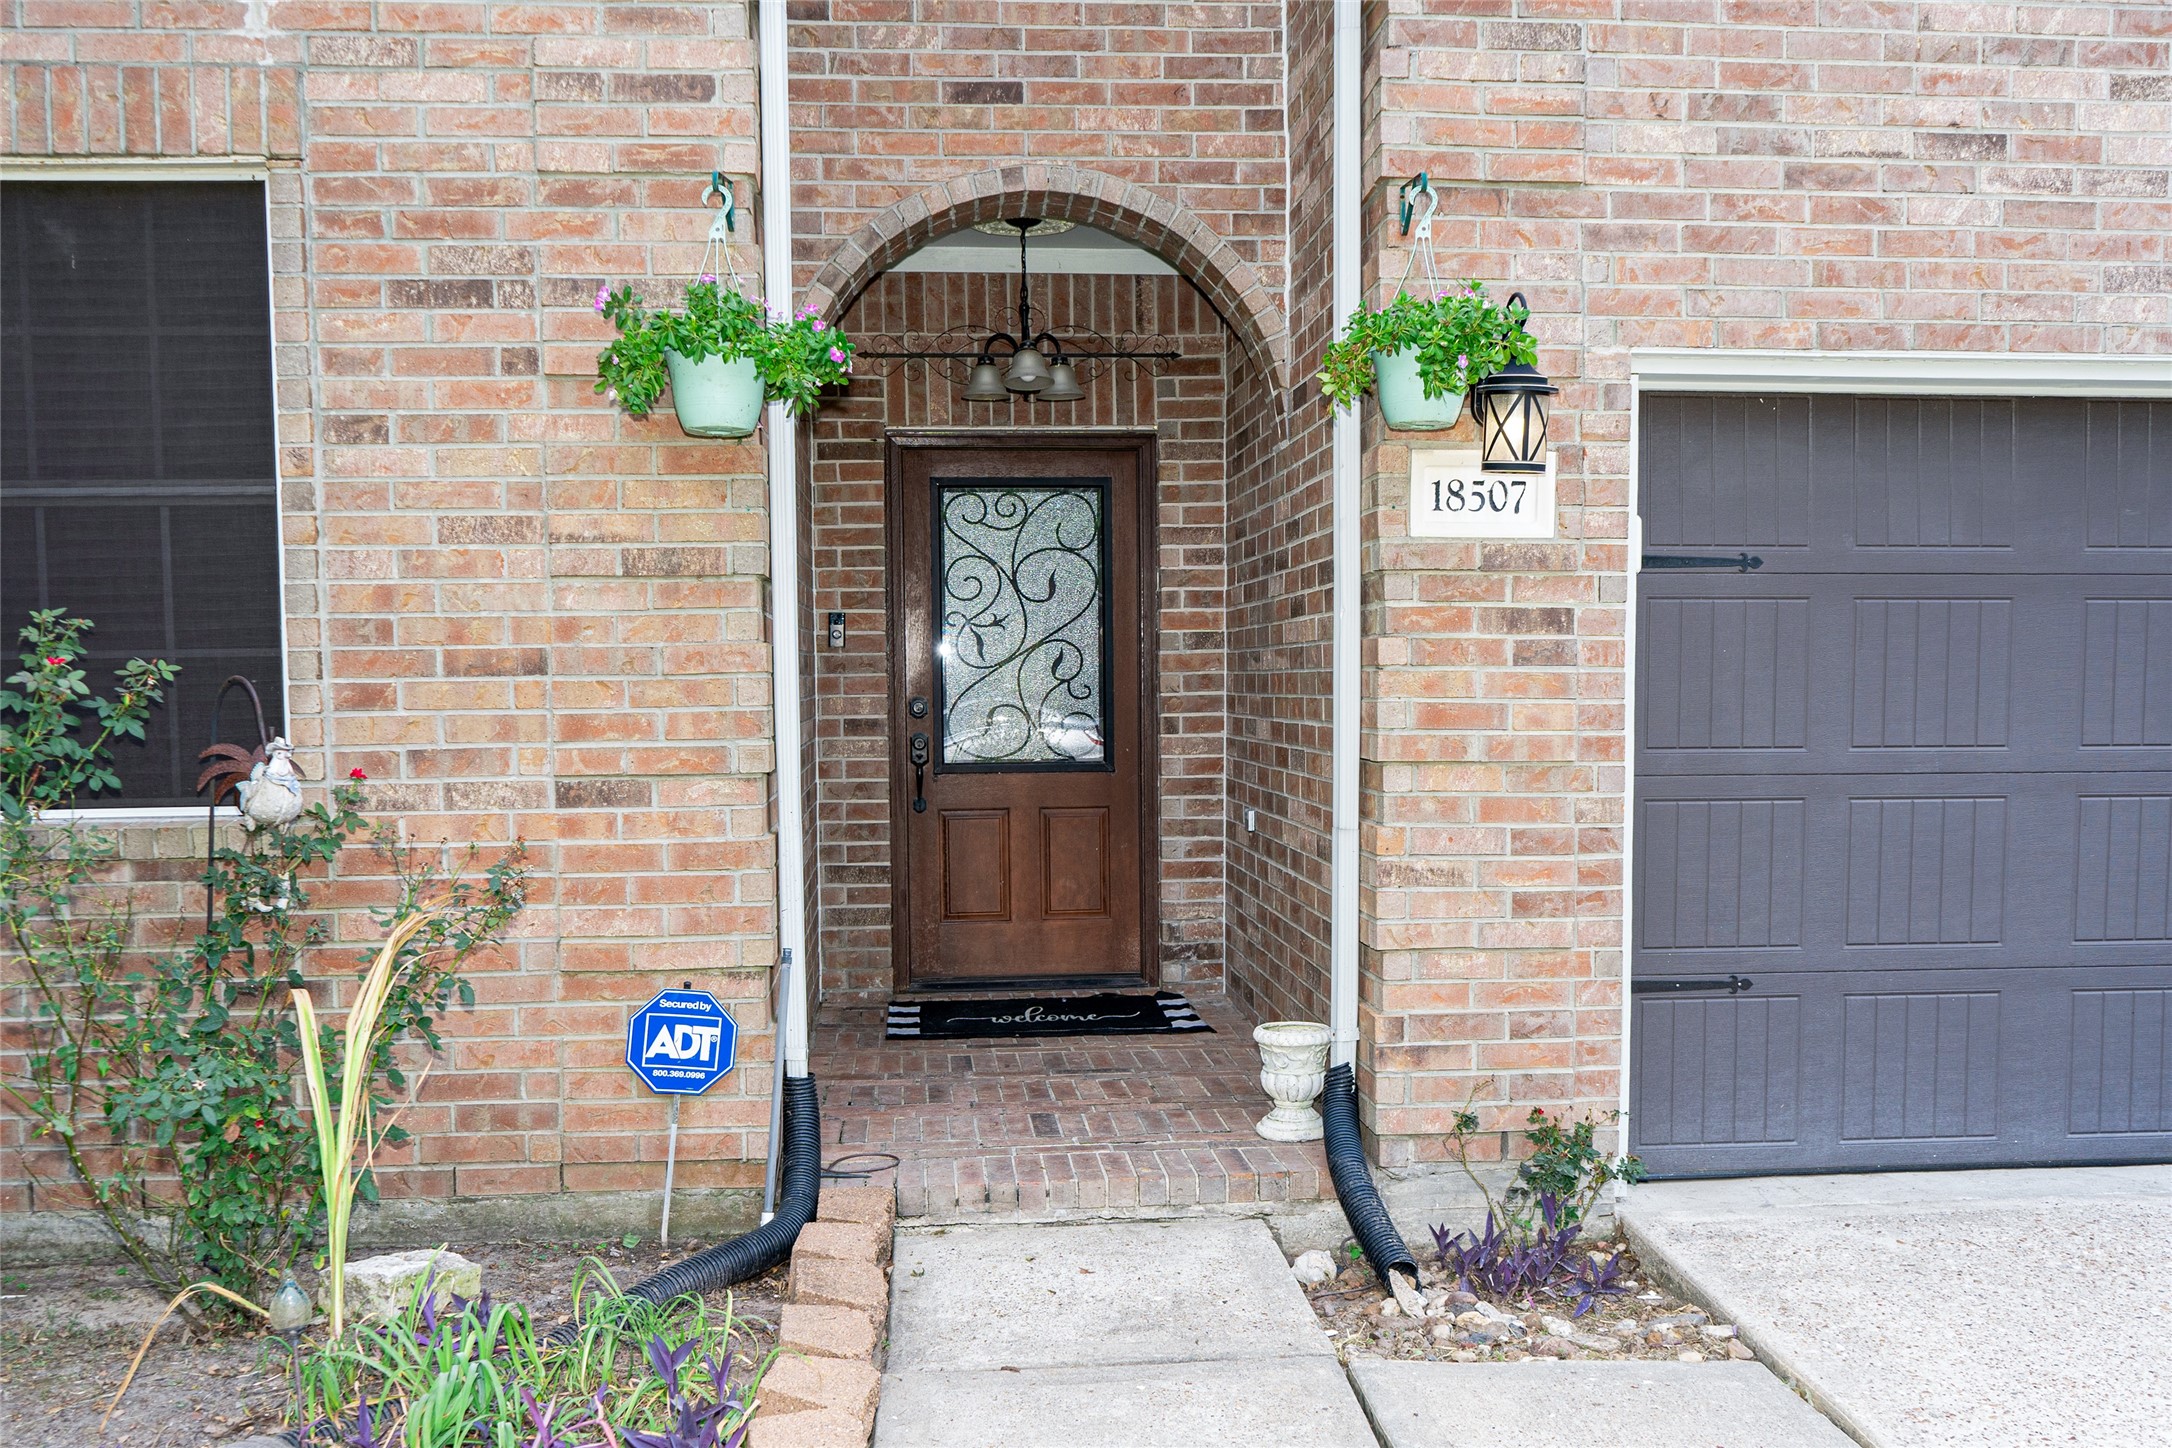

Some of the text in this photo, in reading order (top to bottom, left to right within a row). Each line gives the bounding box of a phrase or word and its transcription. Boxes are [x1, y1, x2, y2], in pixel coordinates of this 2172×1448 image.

[1431, 479, 1527, 514] 18507
[659, 999, 712, 1012] Secured by
[946, 1006, 1140, 1023] welcome
[645, 1024, 719, 1061] ADT
